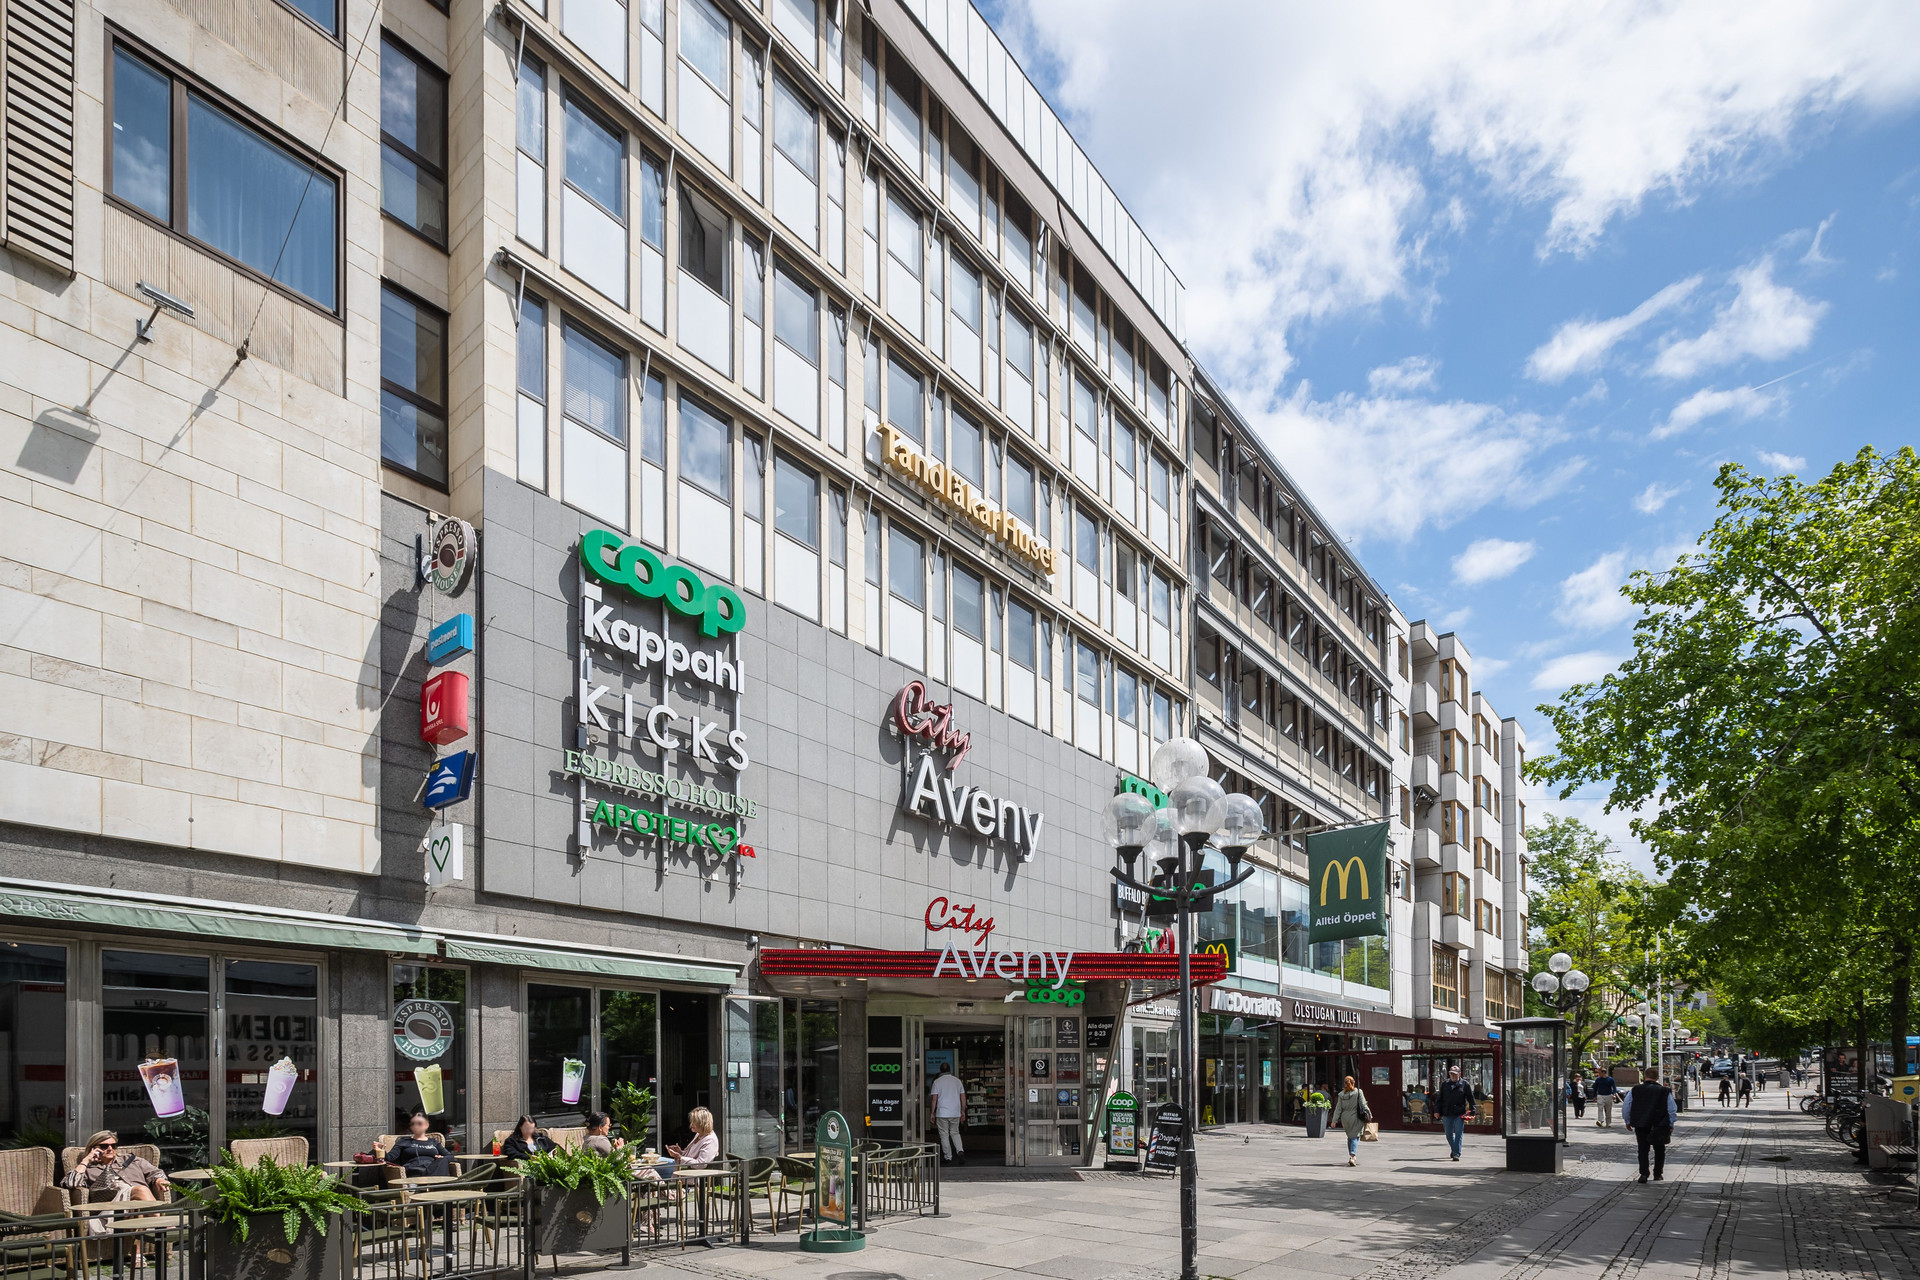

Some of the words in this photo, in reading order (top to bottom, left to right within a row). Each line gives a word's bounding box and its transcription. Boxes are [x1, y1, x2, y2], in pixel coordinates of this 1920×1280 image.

[433, 522, 463, 554] ESPRESSO
[435, 568, 460, 589] HOUSE
[579, 529, 747, 638] coop
[430, 625, 458, 651] postnord
[584, 596, 745, 694] Kappahl
[579, 678, 749, 771] KICKS
[895, 680, 972, 770] City
[564, 749, 683, 799] ESPRESSO
[688, 783, 758, 819] HOUSE
[903, 754, 1044, 863] Aveny
[592, 800, 705, 847] APOTEK
[737, 844, 757, 858] ICA
[1117, 884, 1141, 904] BUFFALO
[925, 896, 996, 946] City
[1315, 915, 1341, 927] Alltid
[1343, 911, 1377, 924] Öppet
[932, 940, 1074, 990] Aveny
[1026, 987, 1087, 1008] coop
[1210, 989, 1282, 1018] McDonald's
[396, 1002, 449, 1025] ESPRESSO
[1294, 1001, 1335, 1021] ÖLSTUGAN
[1337, 1009, 1361, 1024] TULLEN
[402, 1042, 444, 1057] HOUSE
[870, 1063, 901, 1074] coop
[1111, 1099, 1134, 1107] coop
